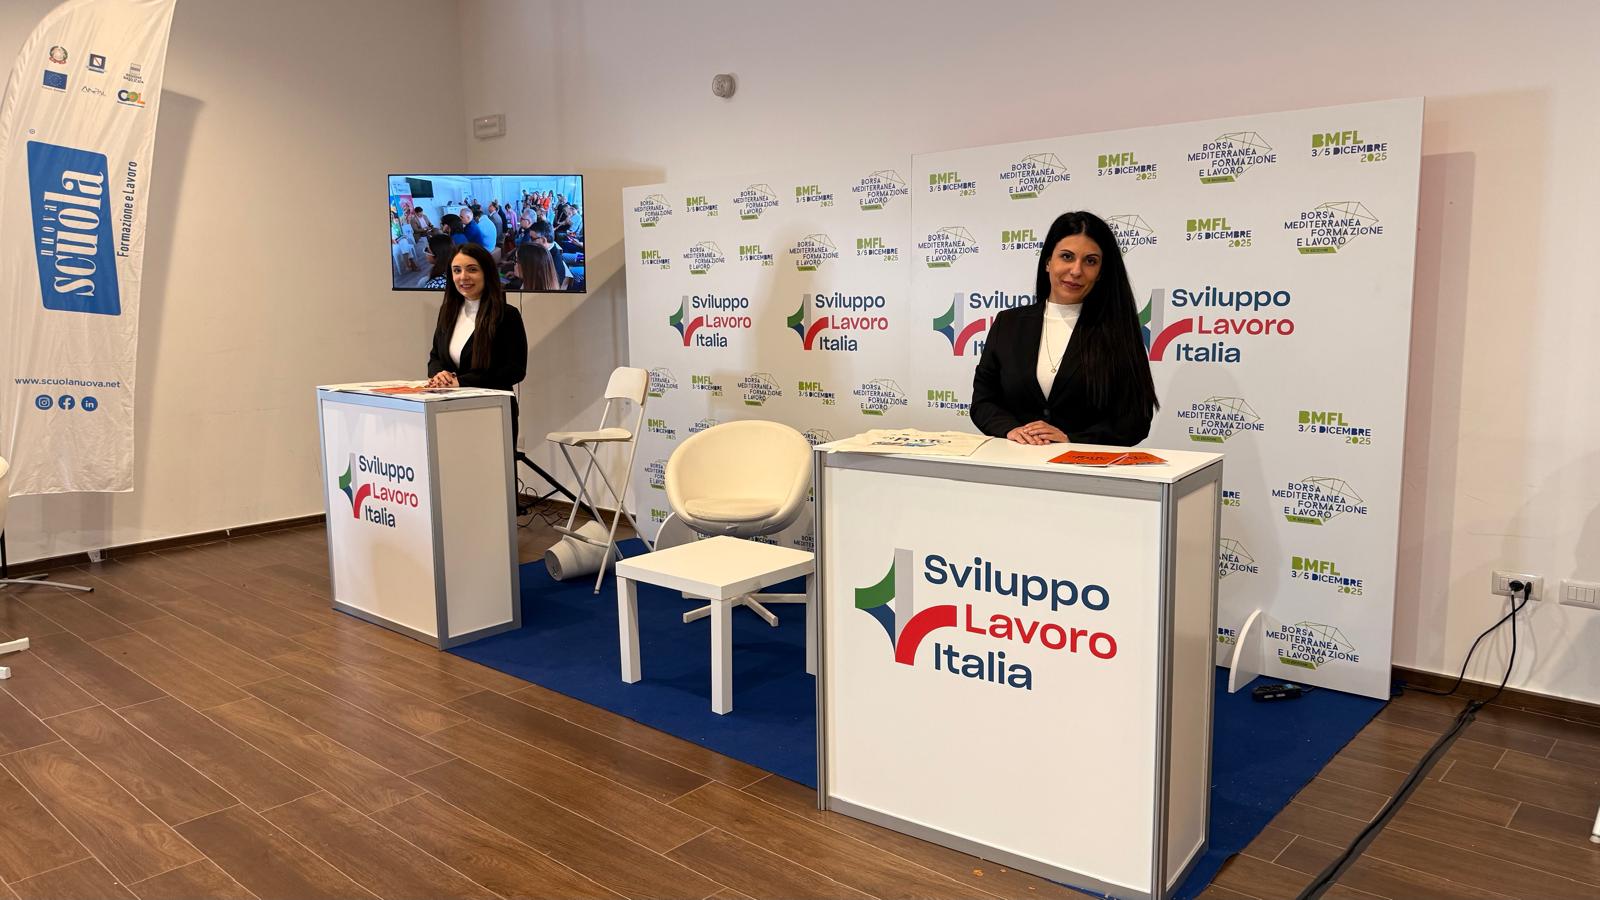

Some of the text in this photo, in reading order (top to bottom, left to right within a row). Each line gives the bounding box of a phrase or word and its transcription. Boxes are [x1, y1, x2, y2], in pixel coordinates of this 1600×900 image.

[1312, 131, 1363, 148] BMFL
[1203, 142, 1233, 151] BORSA
[1333, 143, 1387, 155] DICEMBRE
[1098, 152, 1138, 168] BMFL
[1188, 148, 1256, 161] MEDITERRANEA
[1361, 152, 1387, 162] 2025
[1012, 163, 1036, 171] BORSA
[1212, 155, 1276, 168] FORMAZIONE
[1000, 169, 1055, 179] MEDITERRANEA
[1114, 164, 1157, 175] DICEMBRE
[1199, 166, 1243, 177] E LAVORO
[123, 161, 137, 194] Lavoro
[929, 172, 961, 185] BMFL
[1019, 174, 1071, 185] FORMAZIONE
[1136, 172, 1157, 180] 2025
[796, 185, 821, 196] BMFL
[852, 183, 895, 192] MEDITERRANEA
[868, 188, 908, 197] FORMAZIONE
[943, 182, 976, 191] DICEMBRE
[1016, 184, 1044, 192] LAVORO
[686, 196, 708, 206] BMFL
[807, 194, 833, 202] DICEMBRE
[1301, 211, 1335, 220] BORSA
[1186, 217, 1231, 232] BMFL
[1284, 219, 1361, 229] MEDITERRANEA
[41, 204, 57, 257] nuova
[44, 170, 105, 297] scuola
[117, 204, 134, 258] Formazione
[1002, 229, 1037, 243] BMFL
[1205, 231, 1251, 239] DICEMBRE
[1311, 227, 1383, 237] FORMAZIONE
[857, 237, 885, 249] BMFL
[1016, 241, 1044, 249] DICEMB
[1118, 237, 1157, 246] MAZIONE
[1297, 237, 1346, 246] E LAVORO
[739, 245, 762, 255] BMFL
[935, 247, 979, 255] FORMAZIONE
[692, 294, 749, 311] Sviluppo
[816, 292, 885, 311] Sviluppo
[969, 290, 1037, 309] Svilup
[1171, 286, 1290, 311] Sviluppo
[706, 314, 751, 328] Lavoro
[832, 315, 888, 330] Lavoro
[1198, 316, 1294, 335] Lavoro
[696, 333, 727, 347] Italia
[820, 335, 857, 351] Italia
[1176, 342, 1240, 363] Italia
[15, 377, 120, 388] www.scuolanuova.net
[799, 381, 823, 391] BMFL
[853, 390, 895, 398] MEDITERRANEA
[928, 390, 958, 402] BMFL
[868, 397, 907, 405] FORMAZIONE
[1192, 404, 1222, 412] BORSA
[1178, 411, 1245, 421] MEDITERRANEA
[1299, 411, 1348, 426] BMFL
[1197, 427, 1232, 436] LAVORO
[1201, 420, 1264, 431] FORMAZIONE
[1319, 428, 1371, 436] DICEMBRE
[1345, 436, 1371, 445] 2025
[359, 455, 414, 483] Sviluppo
[1288, 483, 1321, 493] BORSA
[373, 482, 418, 508] Lavoro
[1272, 489, 1346, 504] MEDITERRANEA
[1293, 508, 1331, 519] LAVORO
[1298, 500, 1367, 515] FORMAZIONE
[365, 505, 395, 527] Italia
[1292, 556, 1340, 576] BMFL
[924, 554, 1110, 611] Sviluppo
[1312, 573, 1363, 588] DICEMBRE
[1338, 586, 1363, 595] 2025
[965, 604, 1118, 660] Lavoro
[1282, 625, 1314, 637] BORSA
[1266, 630, 1338, 651] MEDITERRANEA
[1286, 650, 1324, 664] LAVORO
[1292, 644, 1359, 662] FORMAZIONE
[934, 642, 1032, 690] Italia
